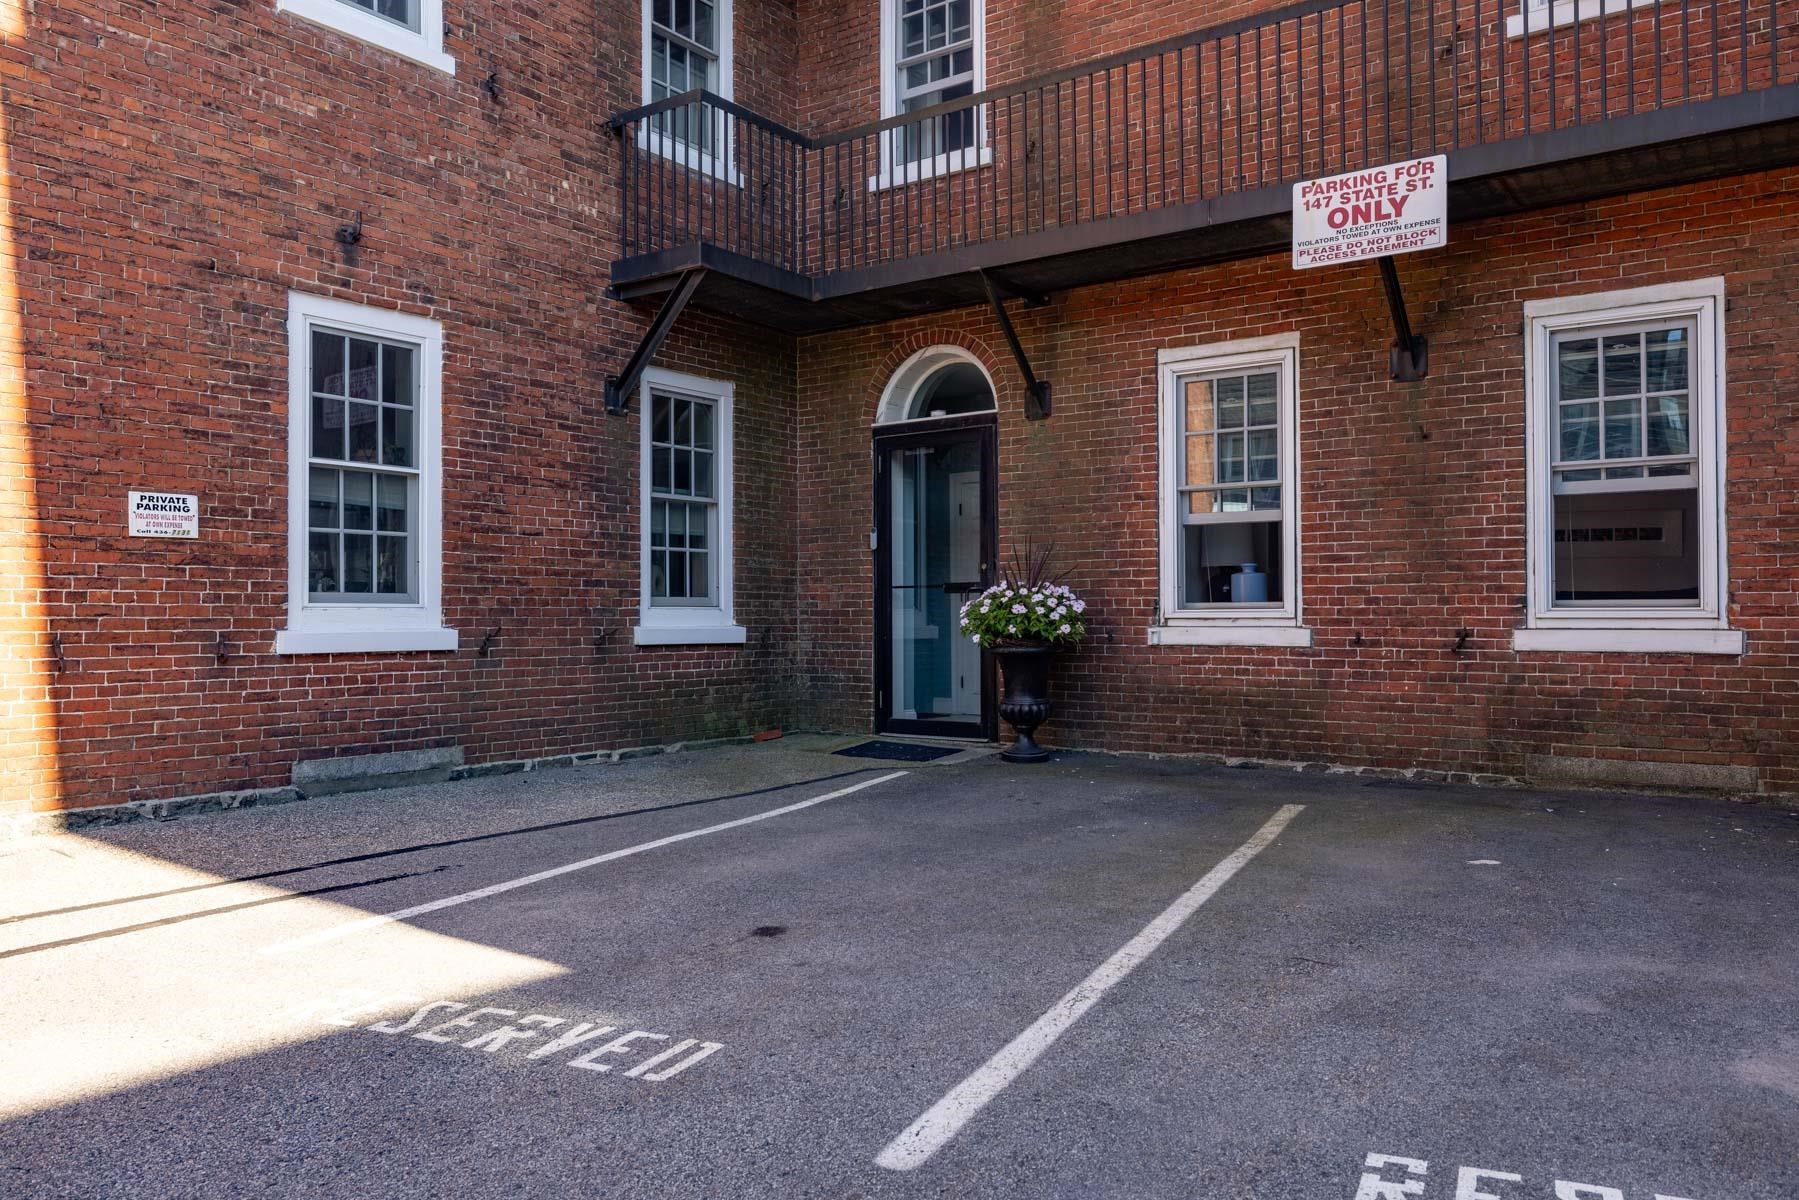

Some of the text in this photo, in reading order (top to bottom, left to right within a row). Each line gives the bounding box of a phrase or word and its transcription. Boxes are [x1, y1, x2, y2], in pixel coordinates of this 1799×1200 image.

[1301, 161, 1435, 198] PARKING FOR
[1303, 175, 1434, 212] 147 STATE ST.
[1327, 194, 1410, 229] ONLY
[1297, 217, 1441, 248] VIOLATORS TOWED AT OWN EXPENSE
[1349, 219, 1399, 233] EXCEPTIONS
[1299, 228, 1437, 257] PLEASE DO NOT BLOCK
[1310, 238, 1426, 263] ACCESS EASEMENT
[136, 503, 191, 513] PARKING
[140, 495, 188, 505] PRIVATE
[160, 513, 171, 521] WILL
